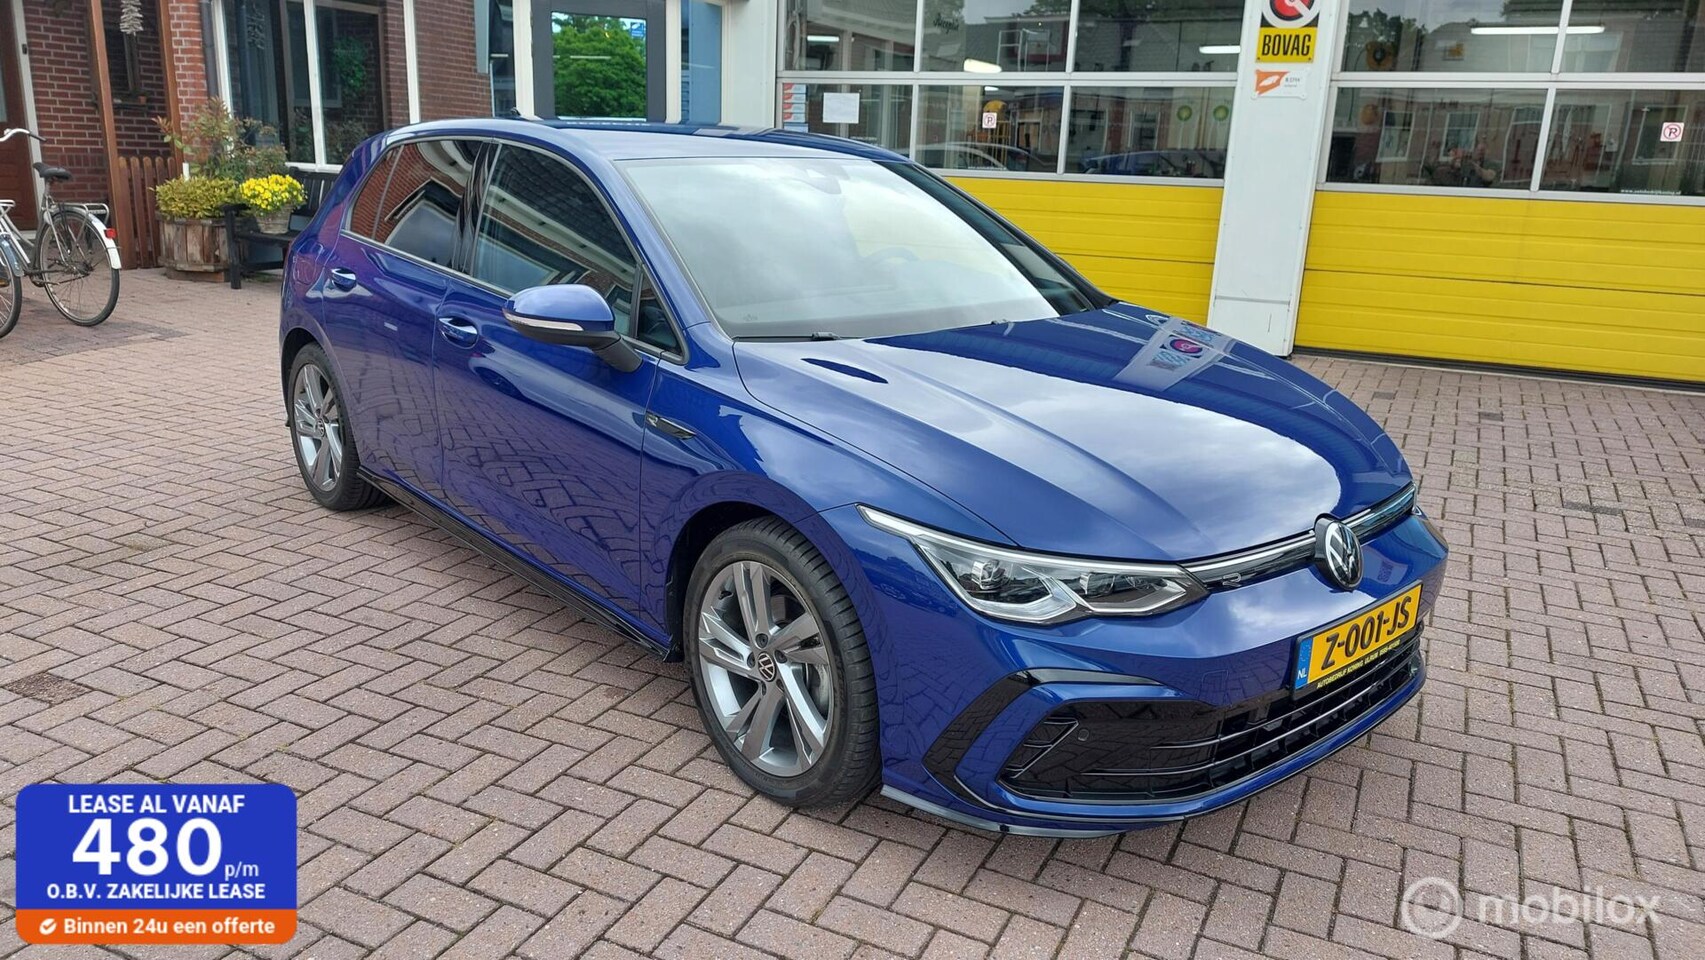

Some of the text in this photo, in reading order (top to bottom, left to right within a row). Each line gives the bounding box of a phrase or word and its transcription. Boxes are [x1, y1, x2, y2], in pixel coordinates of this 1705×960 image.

[1262, 34, 1311, 56] BOVAG
[1321, 595, 1412, 670] Z-001-JS
[1297, 667, 1307, 680] NL
